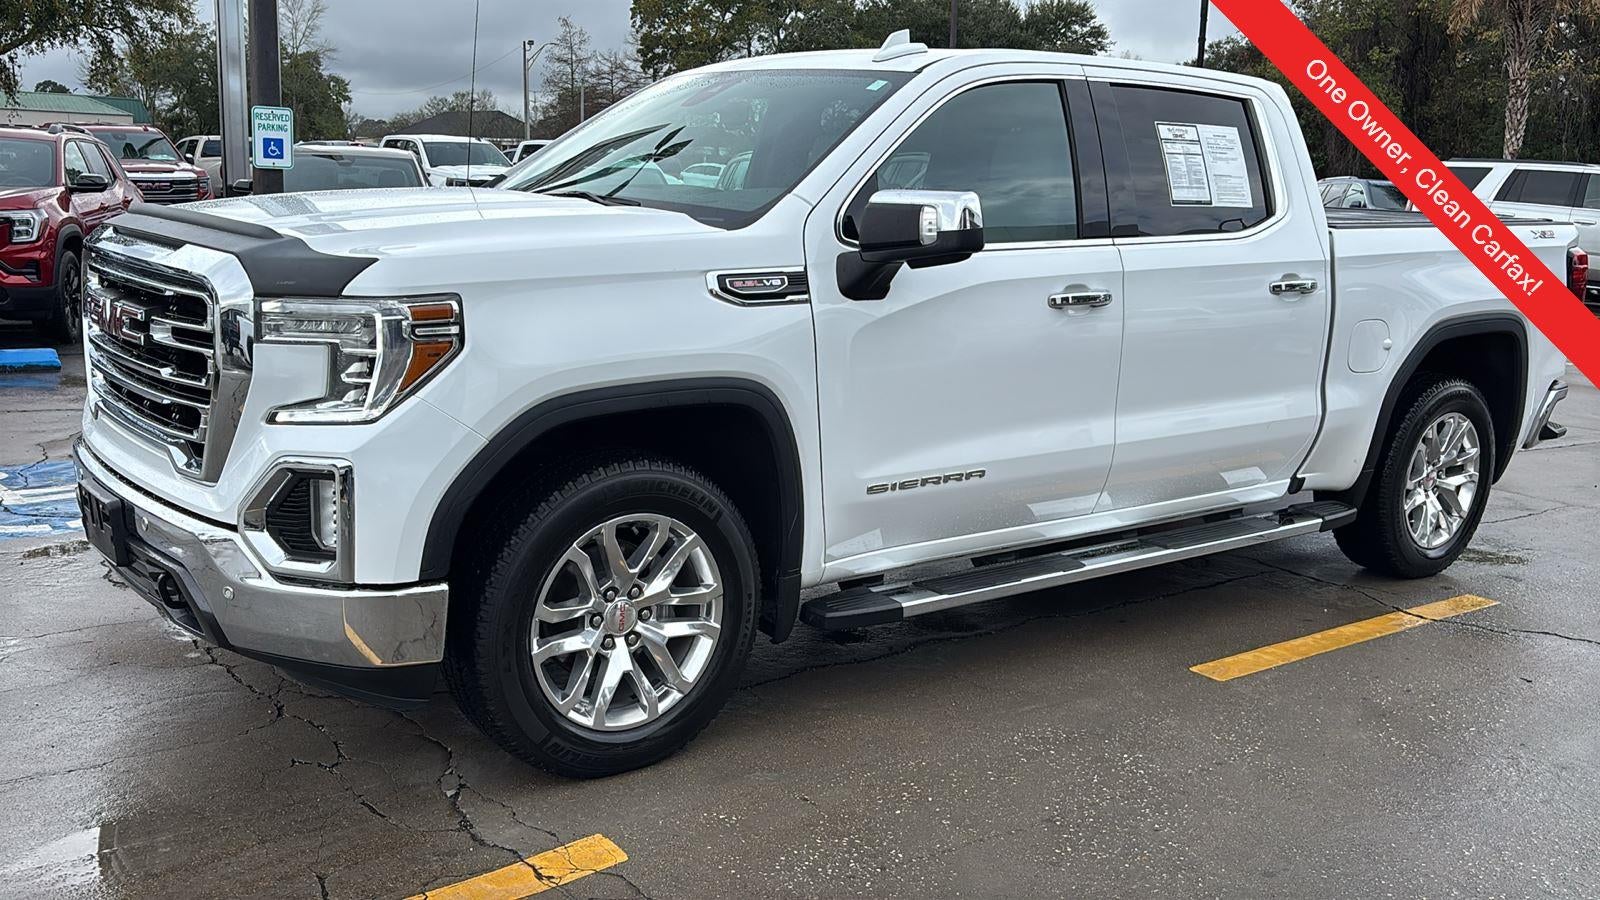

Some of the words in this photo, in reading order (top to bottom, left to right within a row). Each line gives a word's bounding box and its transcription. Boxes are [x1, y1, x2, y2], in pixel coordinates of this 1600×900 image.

[255, 112, 290, 122] RESERVED
[257, 122, 288, 132] PARKING
[86, 292, 147, 346] GMC
[866, 469, 986, 495] SIERRA
[618, 603, 627, 632] GMC
